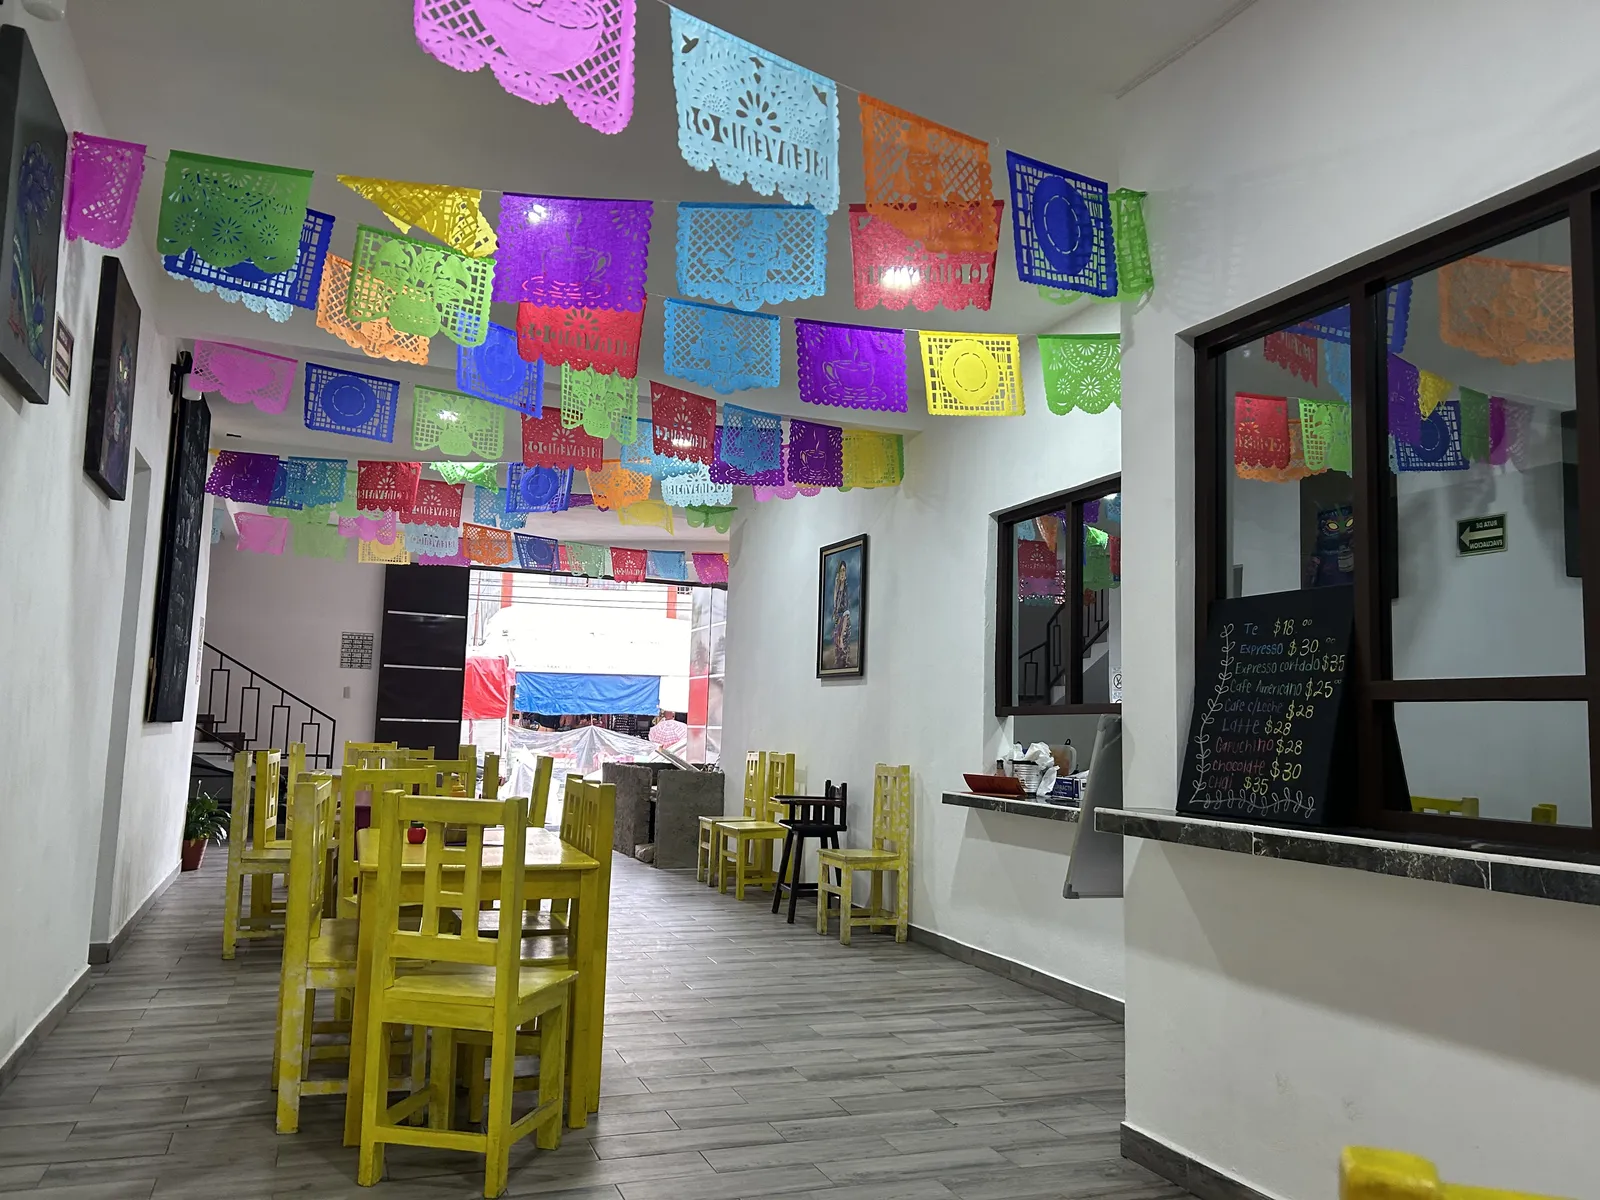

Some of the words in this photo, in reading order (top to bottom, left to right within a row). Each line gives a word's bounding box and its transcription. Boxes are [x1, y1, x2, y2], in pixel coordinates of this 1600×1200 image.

[1286, 699, 1314, 721] $28
[1264, 715, 1292, 736] $28
[1275, 736, 1303, 756] $28
[1270, 756, 1302, 782] $30
[1243, 776, 1269, 796] $35
